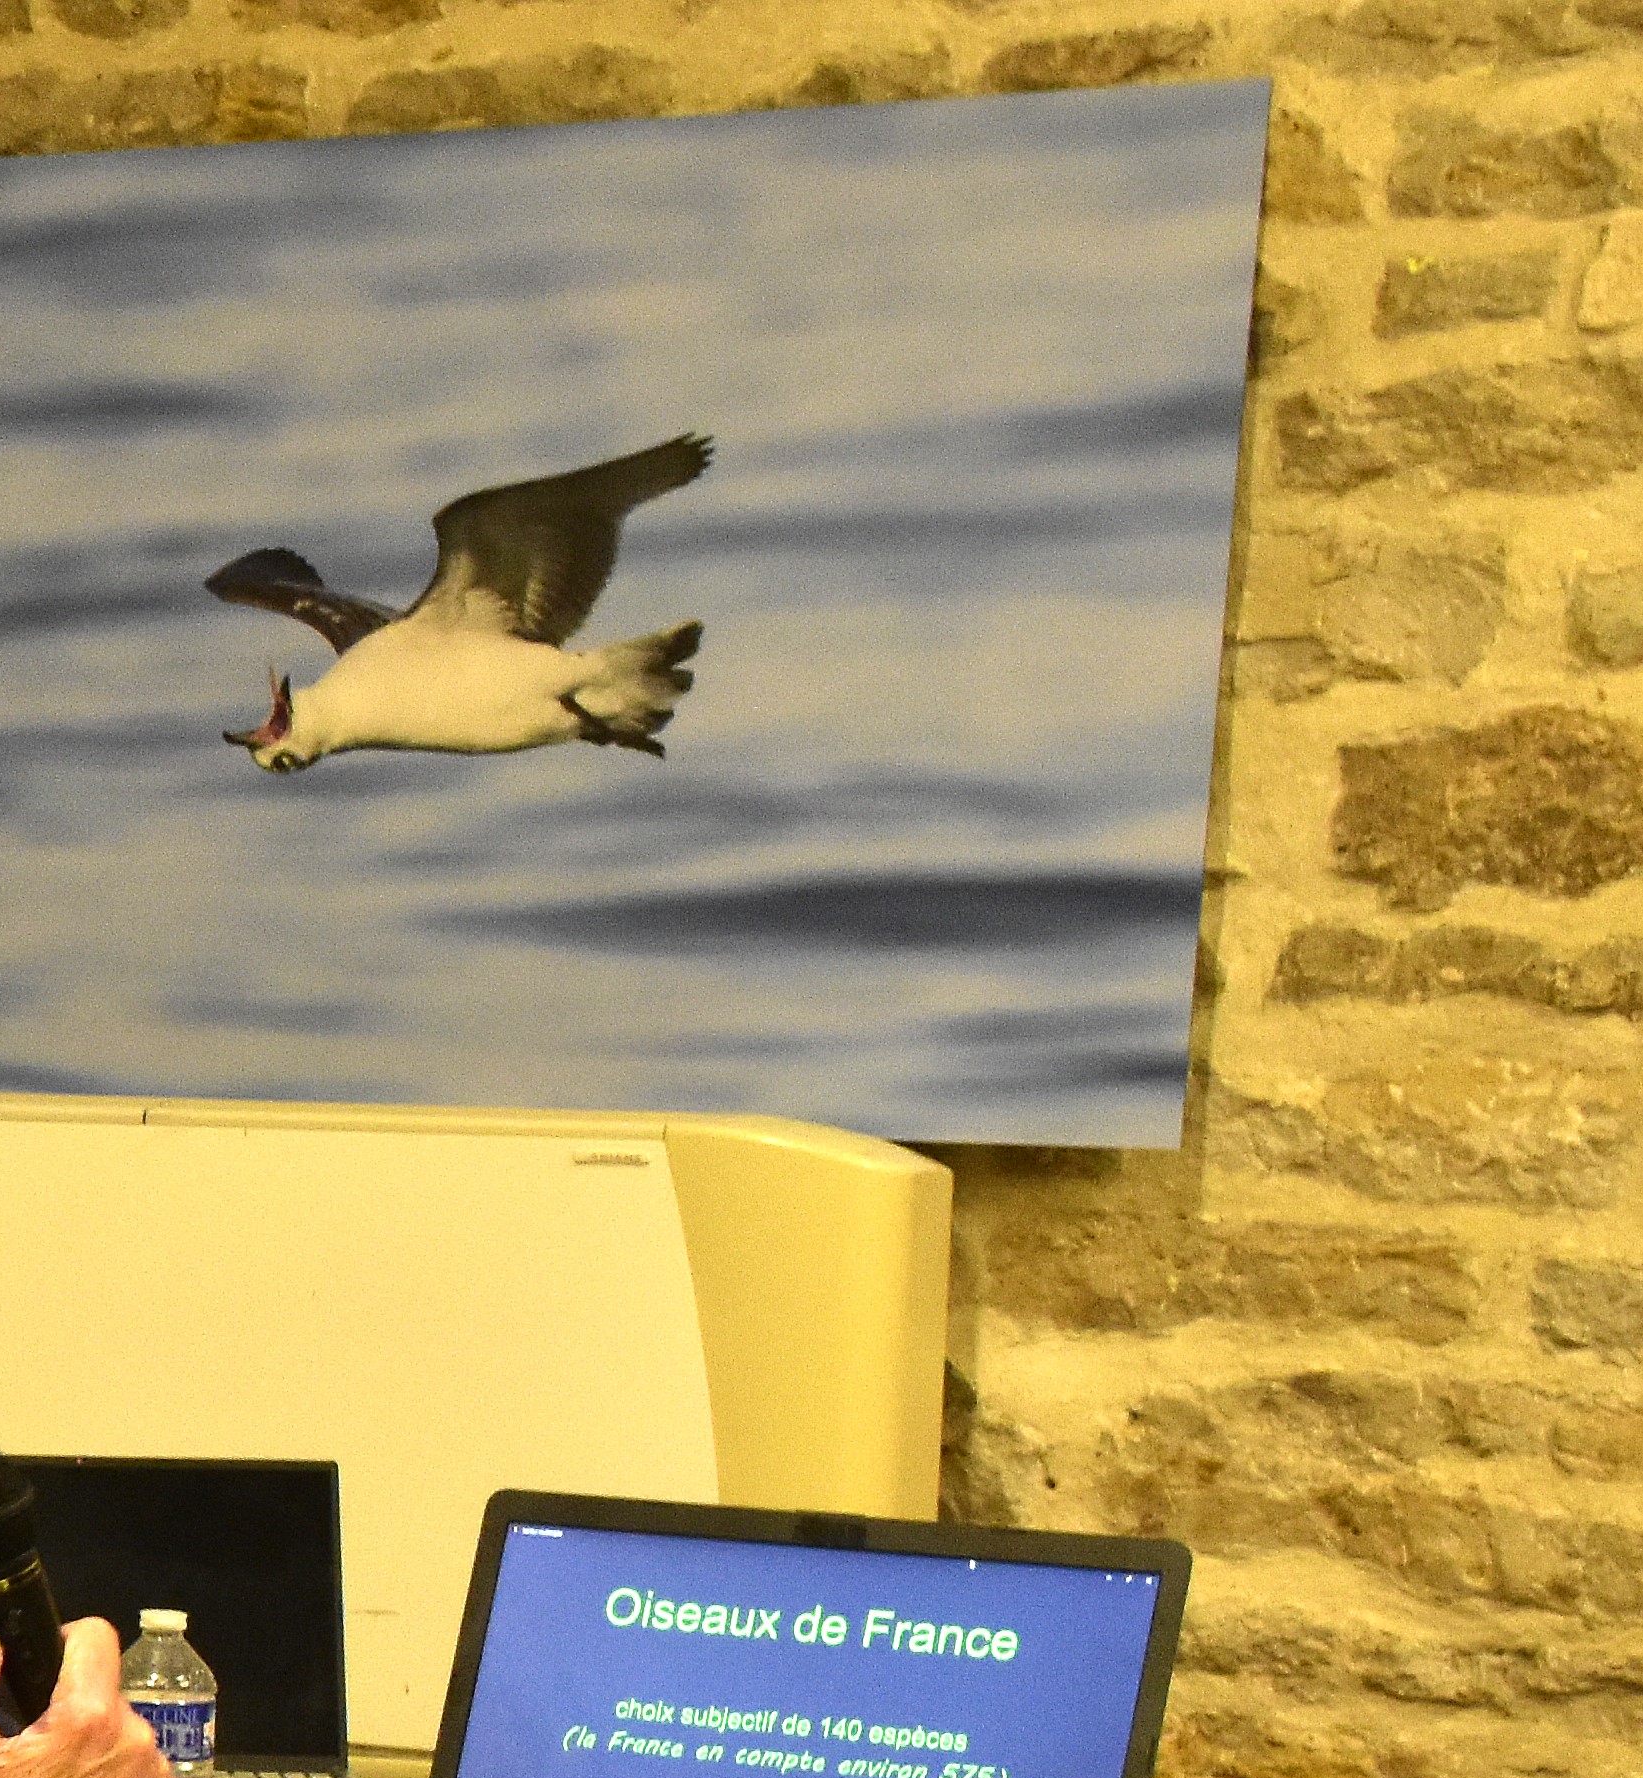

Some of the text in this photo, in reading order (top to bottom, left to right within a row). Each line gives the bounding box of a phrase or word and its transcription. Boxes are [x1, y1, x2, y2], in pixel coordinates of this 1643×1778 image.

[605, 1586, 1020, 1662] Oiseaux de France
[562, 1725, 597, 1752] (la
[607, 1730, 685, 1759] France
[695, 1744, 724, 1763] en
[735, 1748, 826, 1775] compte
[615, 1698, 969, 1753] choix subjectif de 140 espèces
